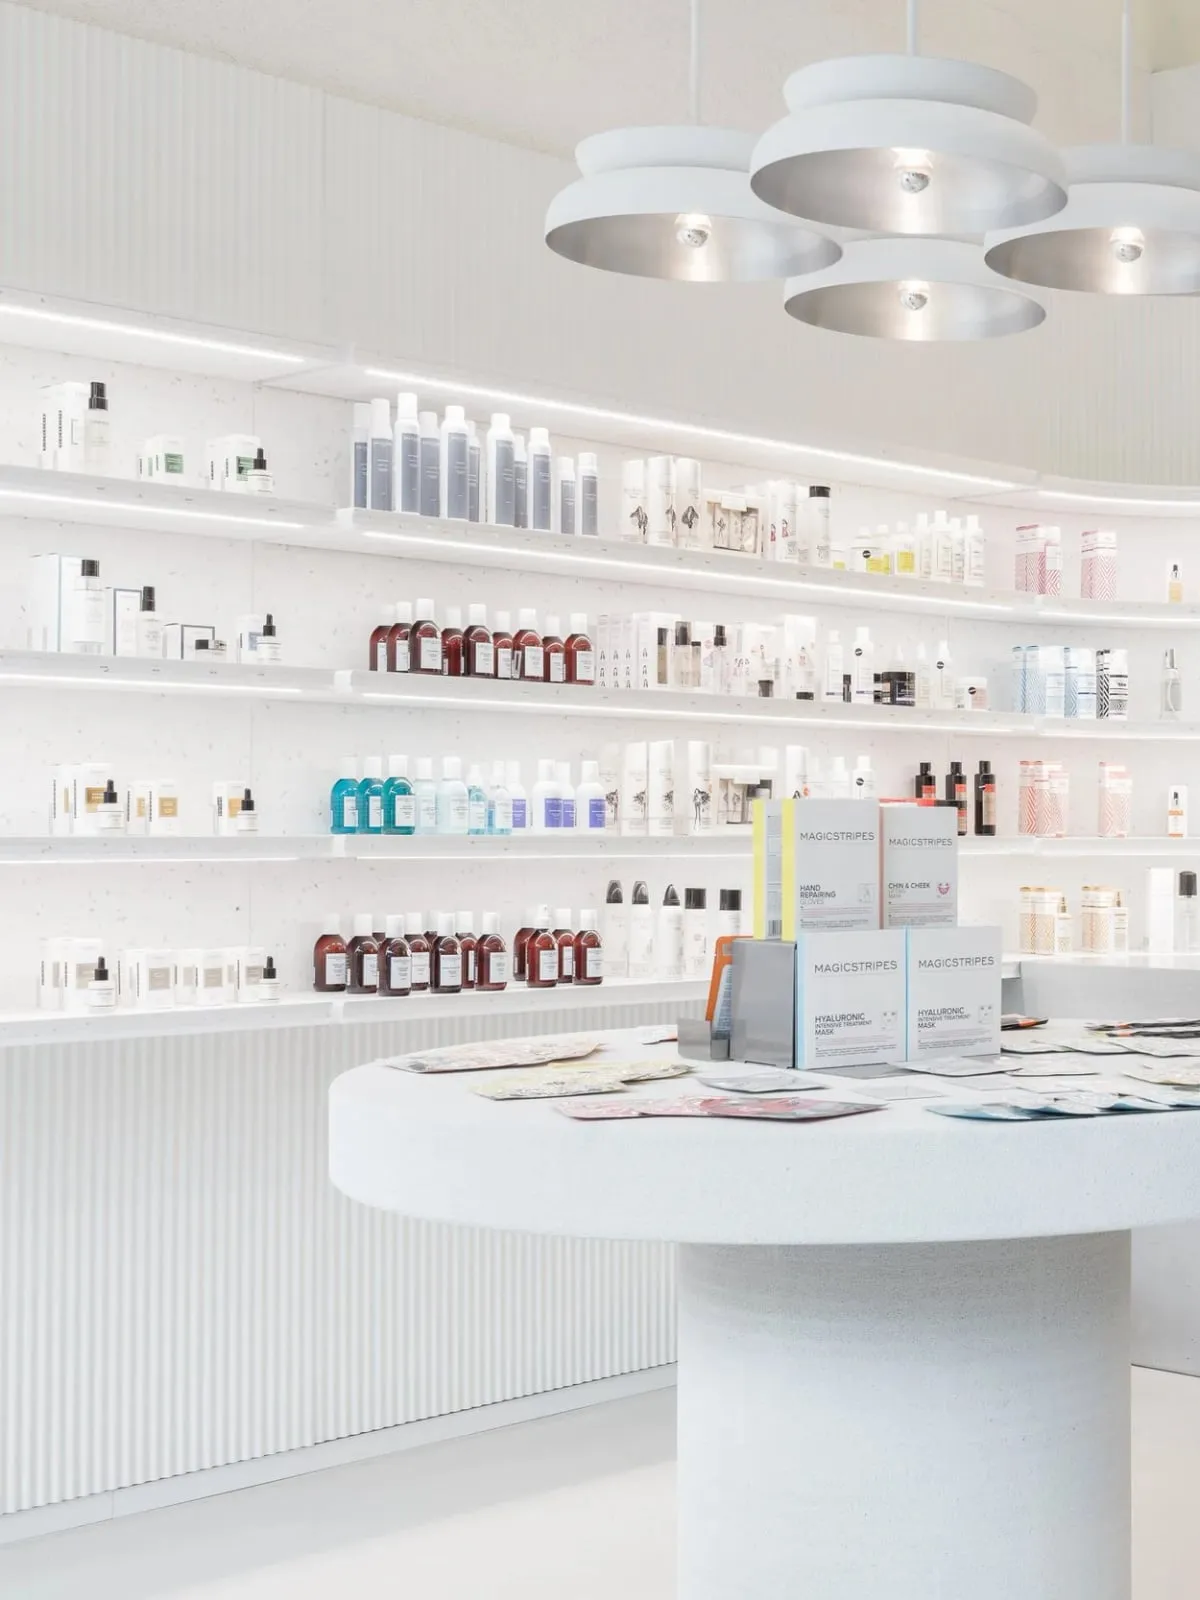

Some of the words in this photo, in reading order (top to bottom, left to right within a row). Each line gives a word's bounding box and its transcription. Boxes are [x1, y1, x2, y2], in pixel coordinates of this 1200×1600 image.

[800, 832, 875, 841] MAGICSTRIPES
[889, 838, 953, 846] MAGICSTRIPES
[800, 884, 821, 892] HAND
[800, 890, 836, 899] REPAIRING
[814, 961, 898, 974] MAGICSTRIPES
[918, 957, 995, 969] MAGICSTRIPES
[918, 1007, 965, 1017] HYALURONIC
[815, 1012, 865, 1023] HYALURONIC
[815, 1028, 834, 1036] MASK
